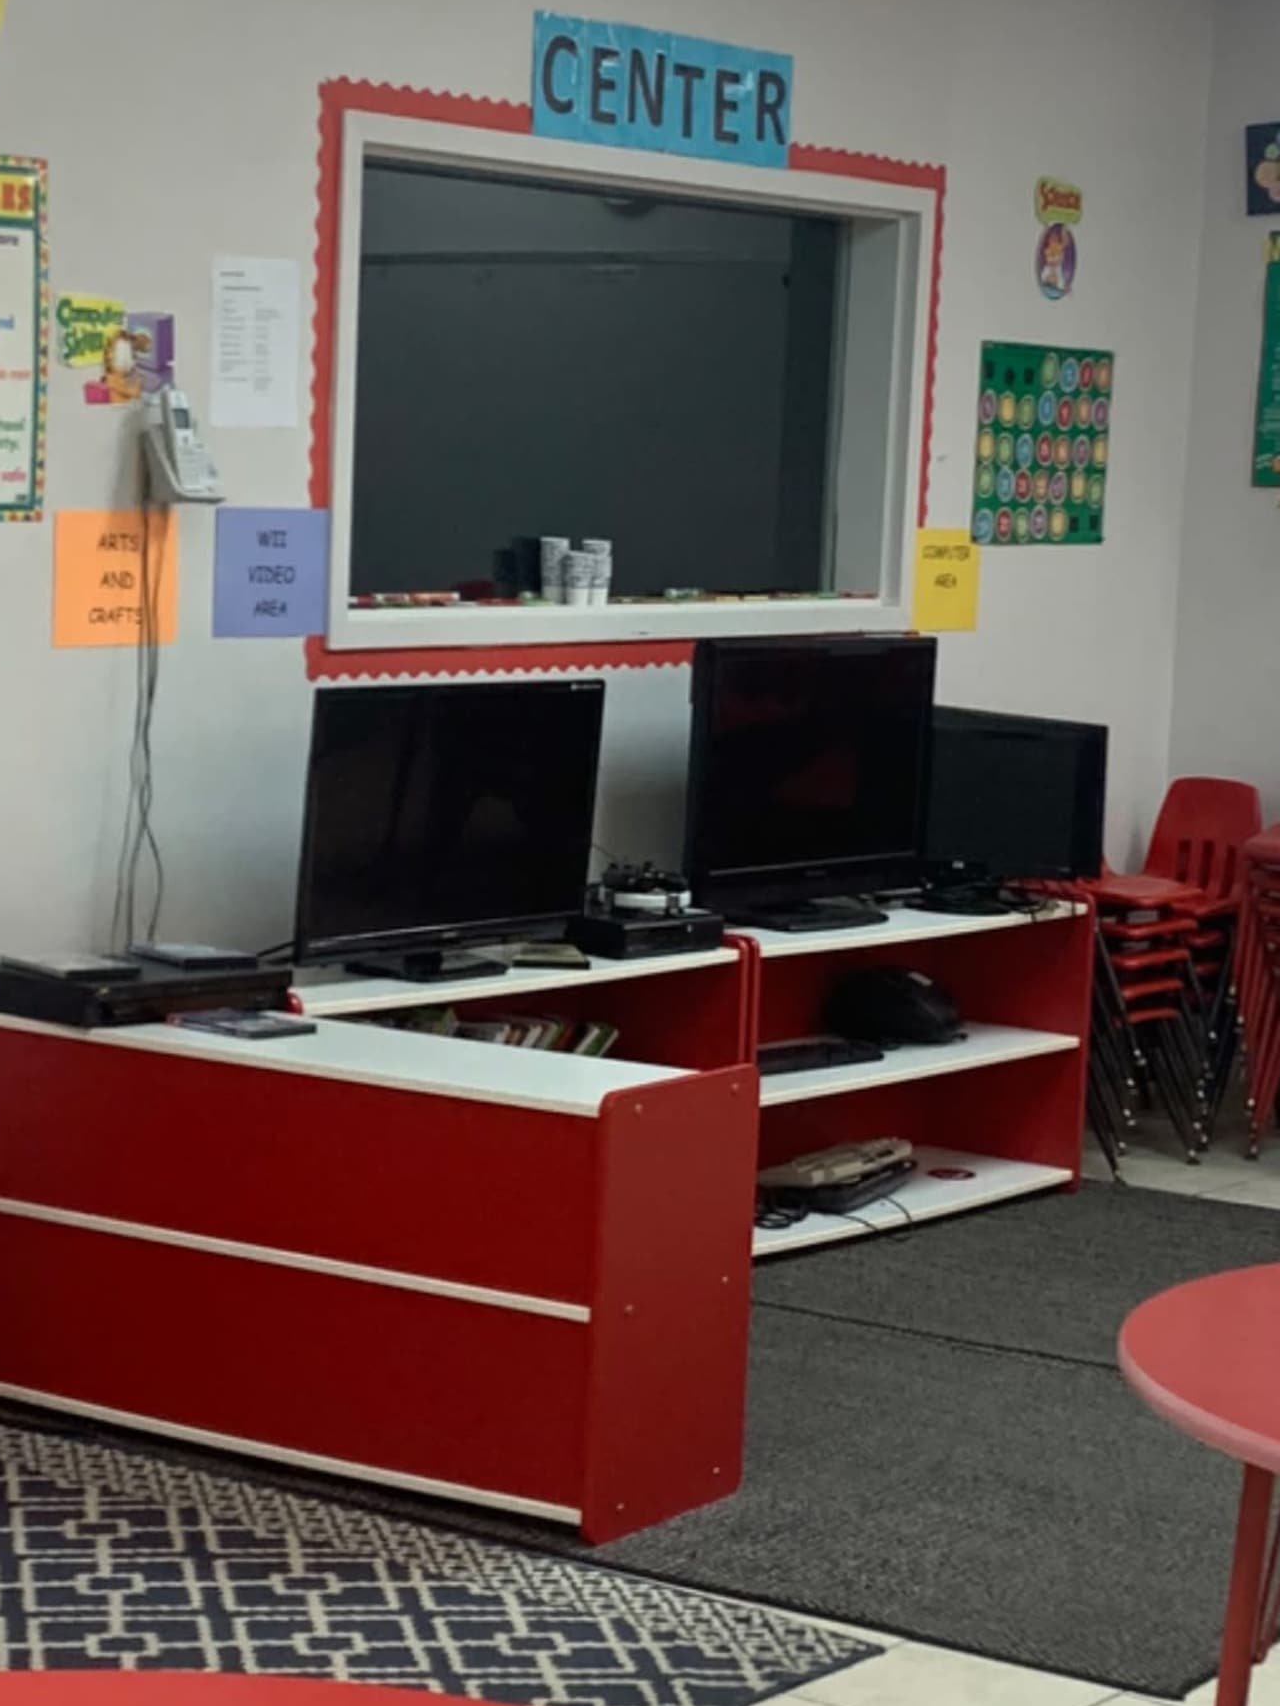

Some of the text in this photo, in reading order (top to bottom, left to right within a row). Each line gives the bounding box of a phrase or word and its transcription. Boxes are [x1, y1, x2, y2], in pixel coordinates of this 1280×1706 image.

[541, 34, 787, 146] CENTER
[97, 532, 142, 553] ARTS
[256, 529, 288, 549] WII
[100, 571, 136, 590] AND
[247, 565, 296, 585] VIDEO
[87, 605, 144, 626] CRAFTS
[252, 599, 288, 618] AREA
